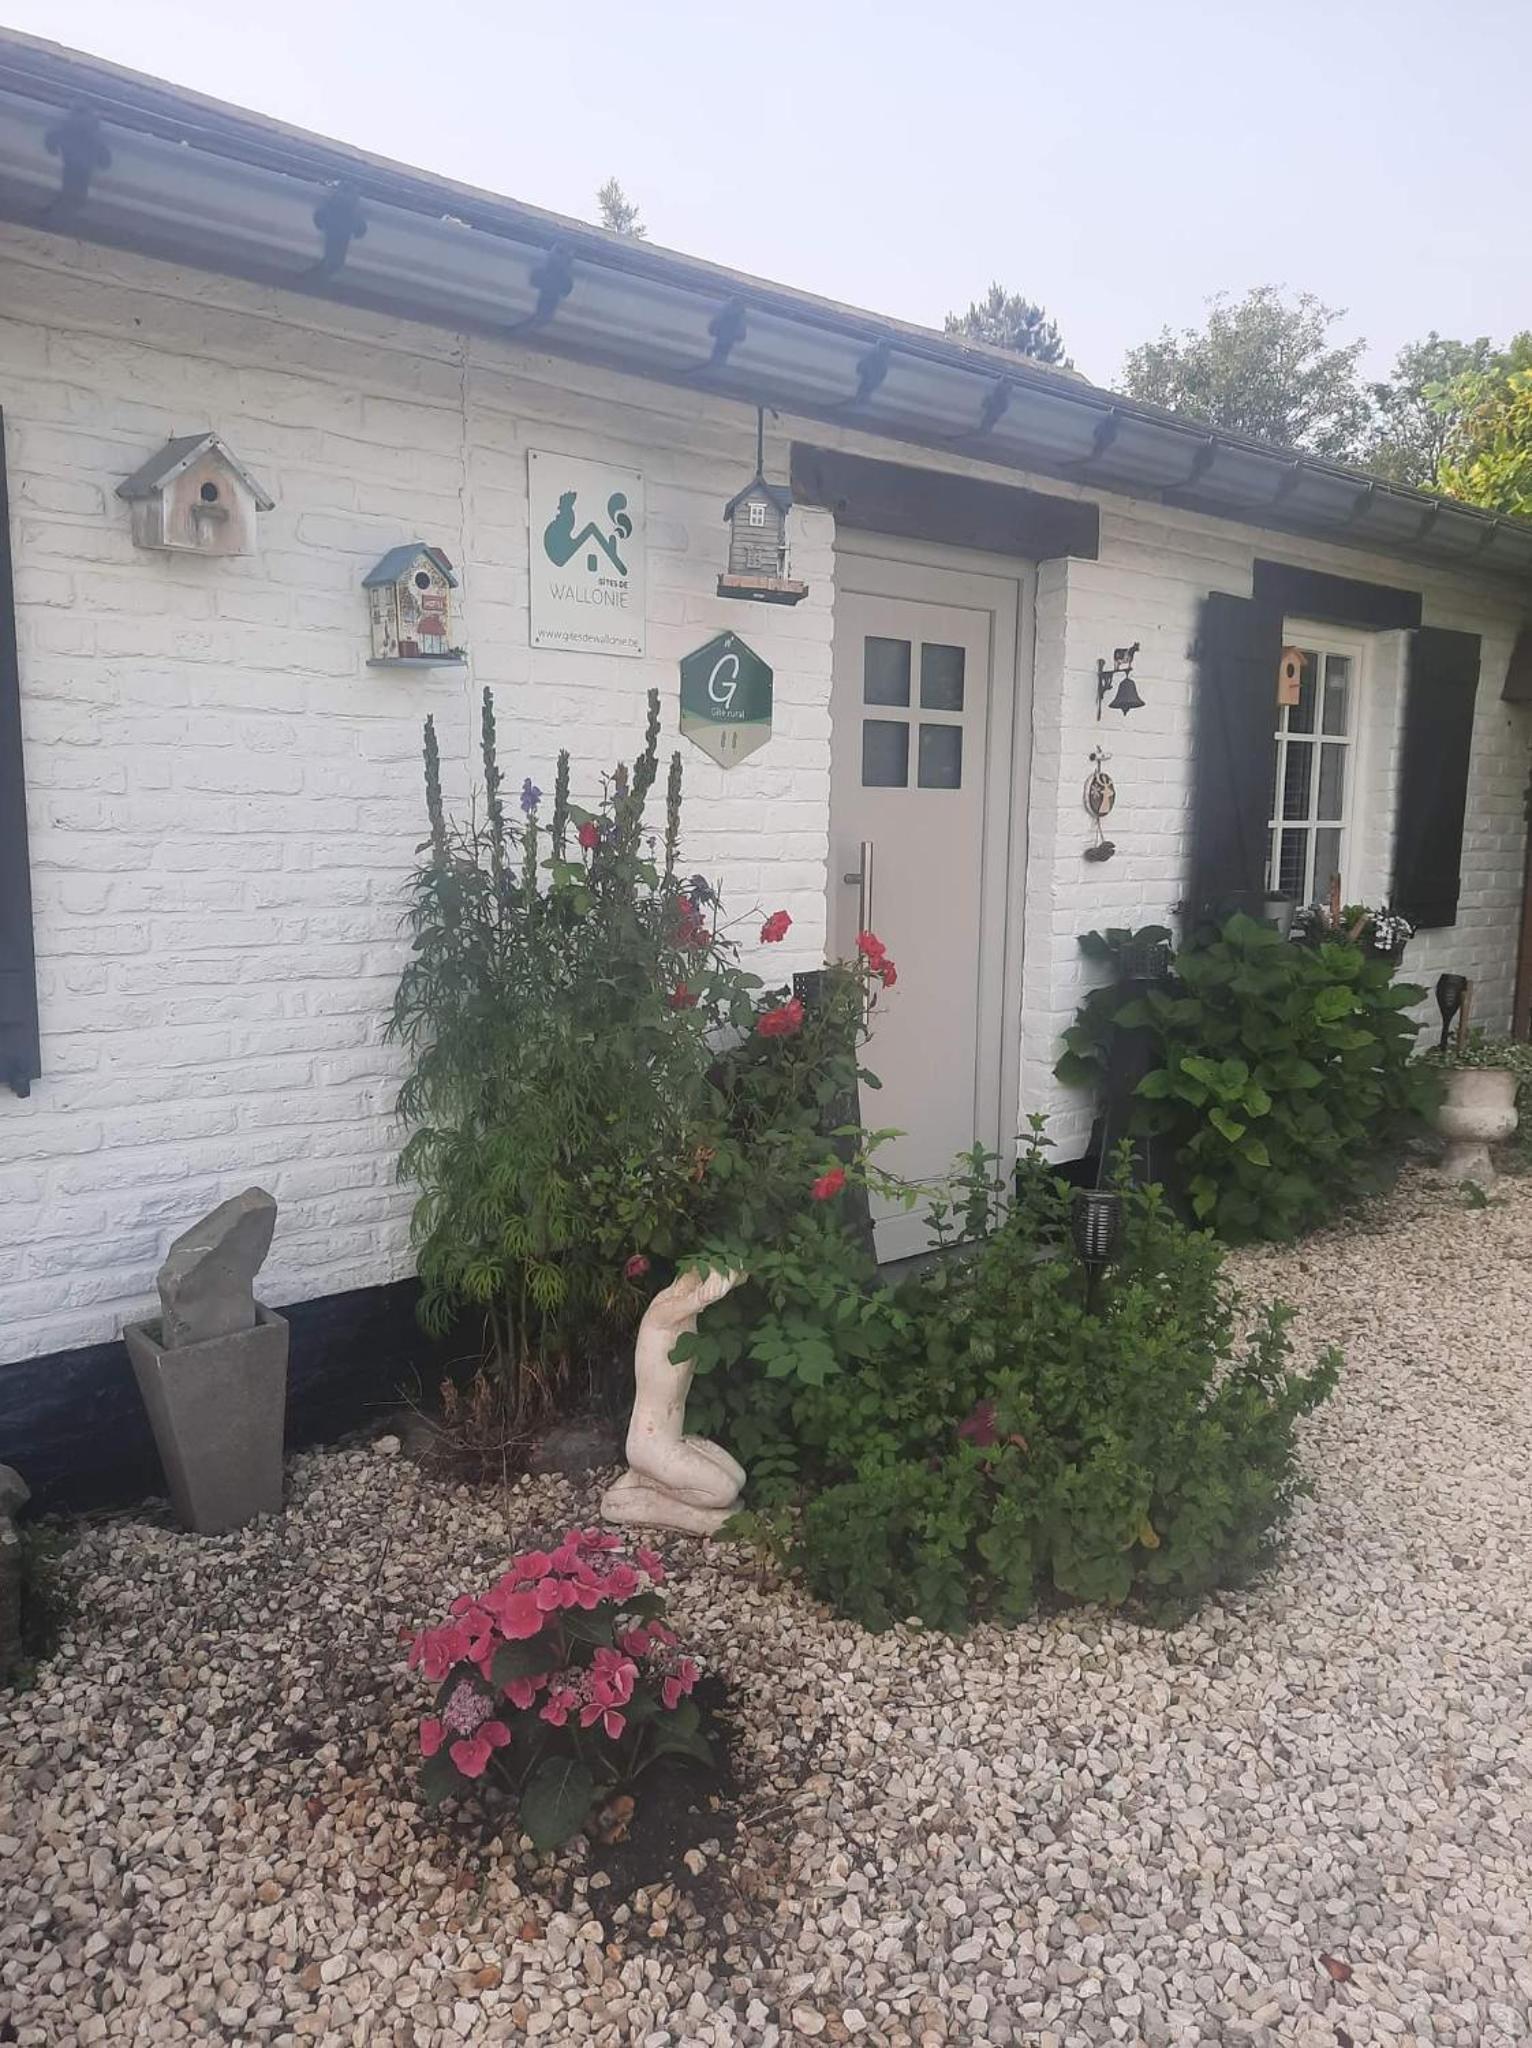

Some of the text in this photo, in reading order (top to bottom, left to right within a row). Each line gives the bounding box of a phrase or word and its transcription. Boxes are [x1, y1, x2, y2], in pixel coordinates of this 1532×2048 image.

[618, 580, 629, 589] DE
[550, 584, 629, 608] WALLONIE
[708, 653, 739, 710] G
[727, 709, 744, 719] rural
